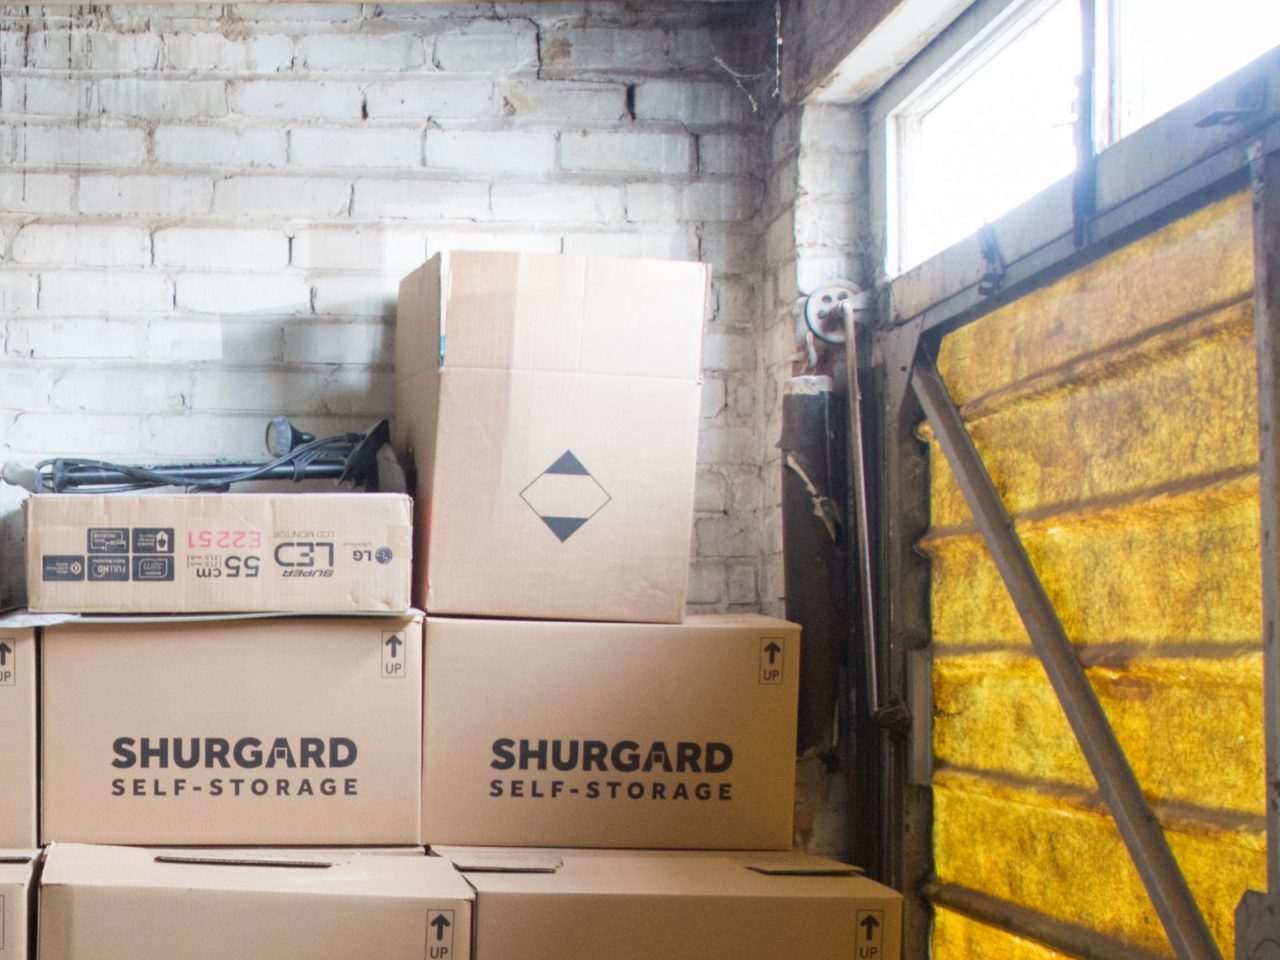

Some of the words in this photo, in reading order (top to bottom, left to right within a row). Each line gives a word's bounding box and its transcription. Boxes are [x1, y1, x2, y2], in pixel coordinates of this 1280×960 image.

[187, 530, 262, 549] E2251
[272, 529, 315, 539] MONITOR
[316, 530, 335, 539] LCD
[273, 542, 335, 567] LED
[352, 550, 372, 562] LG
[196, 568, 222, 578] cm
[224, 555, 261, 578] 55
[282, 569, 335, 578] SUPER
[384, 663, 402, 674] UP
[763, 669, 780, 681] UP
[111, 736, 358, 769] SHURGARD
[490, 738, 734, 774] SHURGARD
[111, 778, 358, 797] SELF-STORAGE
[490, 780, 733, 802] SELF-STORAGE
[430, 947, 448, 960] UP
[859, 946, 878, 959] UP
